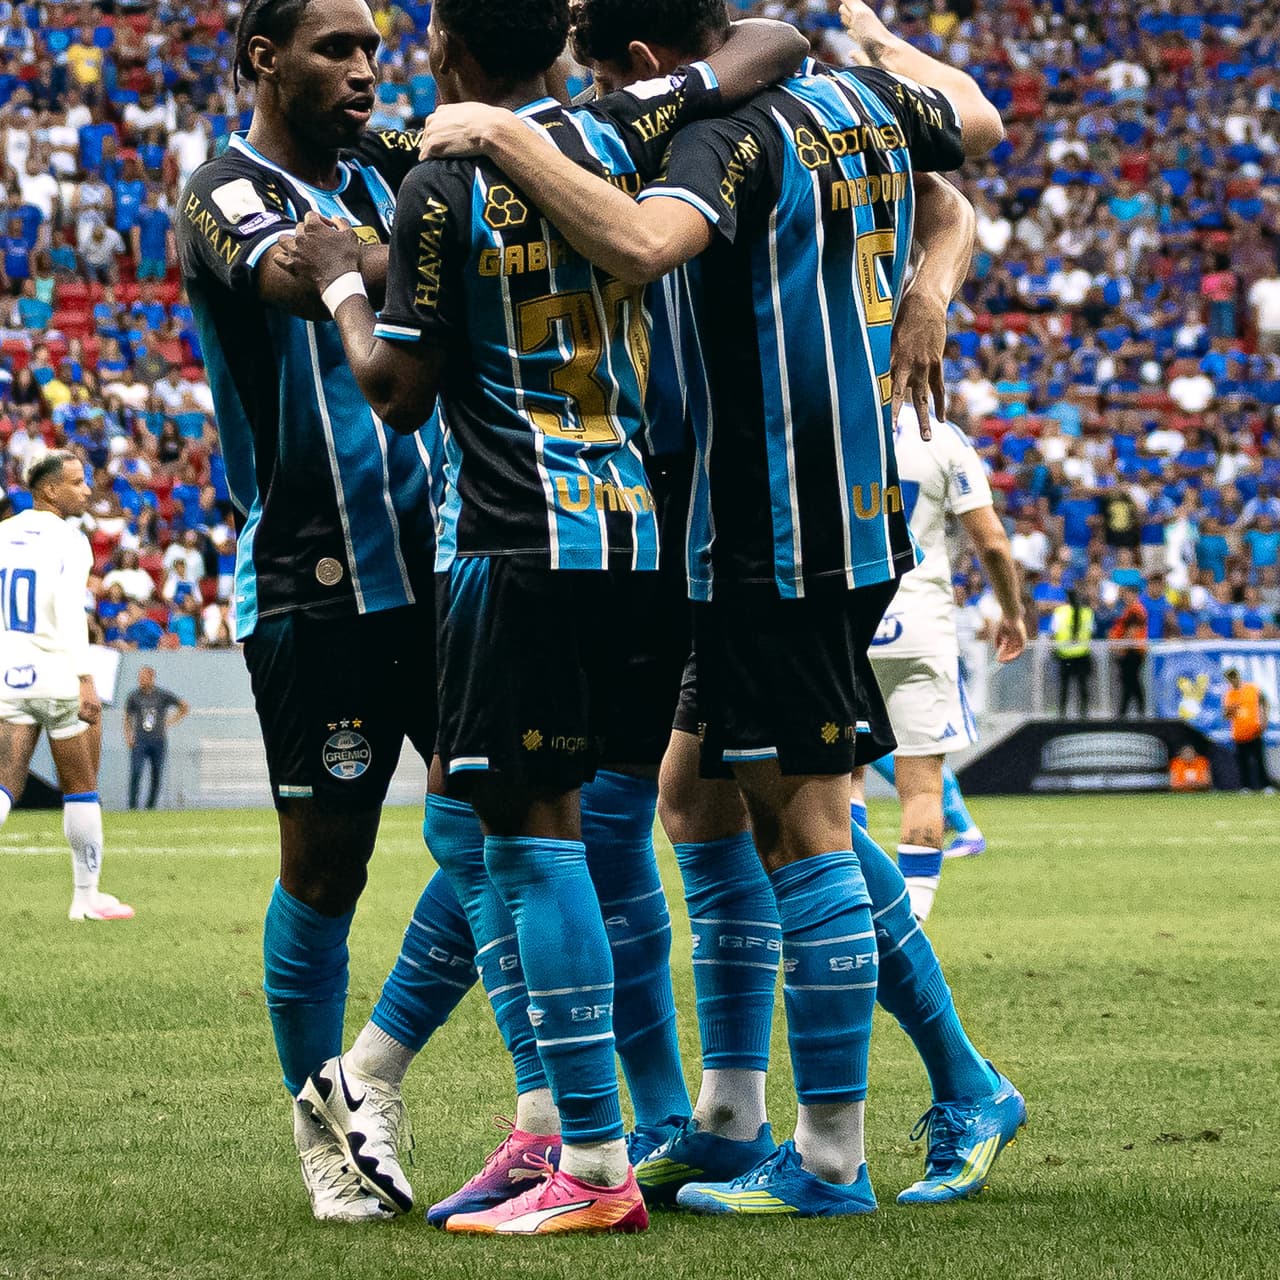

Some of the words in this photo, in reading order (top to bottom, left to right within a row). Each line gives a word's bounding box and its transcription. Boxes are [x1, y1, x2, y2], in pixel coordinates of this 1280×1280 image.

[379, 130, 425, 151] HAV
[183, 191, 242, 265] HAVAN
[414, 196, 449, 309] HAVAN
[479, 241, 565, 277] GABR
[554, 475, 657, 513] Unim
[852, 481, 901, 520] Un
